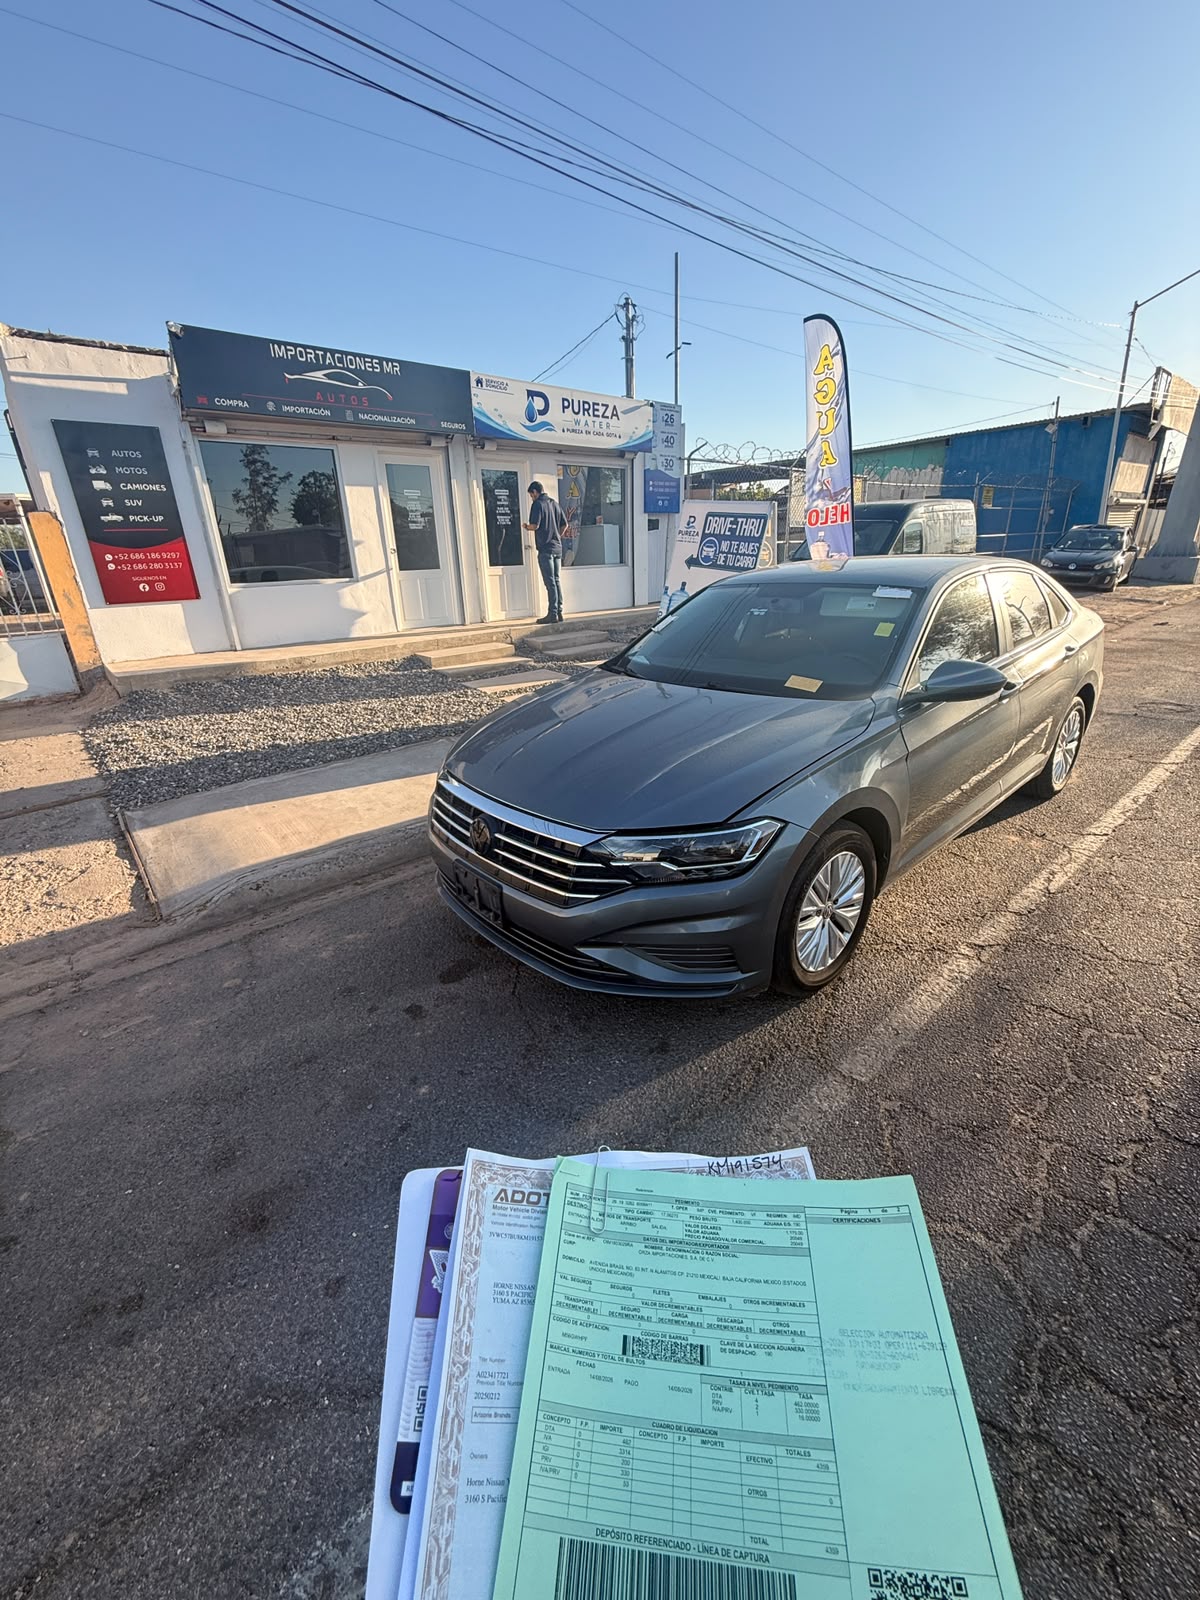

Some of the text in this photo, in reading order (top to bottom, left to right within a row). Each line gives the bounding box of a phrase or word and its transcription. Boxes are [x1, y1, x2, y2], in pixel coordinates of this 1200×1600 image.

[270, 343, 400, 376] IMPORTACIONES MR
[316, 392, 368, 406] AUTOS
[562, 397, 620, 420] PUREZA
[215, 398, 466, 430] COMPRA IMPORTACIÓN NACIONALIZACIÓN SEGUROS
[574, 418, 610, 429] WATER
[112, 450, 142, 458] AUTOS
[115, 466, 148, 474] MOTOS
[120, 483, 166, 492] CAMIONES
[705, 516, 764, 537] DRIVE-THRU
[720, 540, 759, 555] NO TE BAJES
[717, 554, 756, 568] DE TU CARRO
[707, 1154, 782, 1175] KM191574
[494, 1188, 550, 1206] ADOT
[570, 1276, 592, 1285] SEGUROS
[564, 1296, 594, 1306] TRANSPORTE
[658, 1303, 703, 1312] DECREMENTABLES
[706, 1323, 752, 1332] DECREMENTABLES
[576, 1360, 596, 1368] FECHAS
[548, 1365, 570, 1375] ENTRADA
[652, 1421, 674, 1430] CUADRO
[543, 1414, 811, 1457] CONCEPTO IMPORTE CONCEPTO IMPORTE TOTALES
[541, 1455, 552, 1463] PRV
[746, 1455, 773, 1464] EFECTIVO
[466, 1478, 505, 1487] Horne Nissan
[747, 1488, 768, 1497] OTROS
[465, 1495, 486, 1503] 3160 S
[595, 1527, 770, 1564] DEPÓSITO REFERENCIADO LÍNEA DE CAPTURA
[750, 1536, 769, 1546] TOTAL
